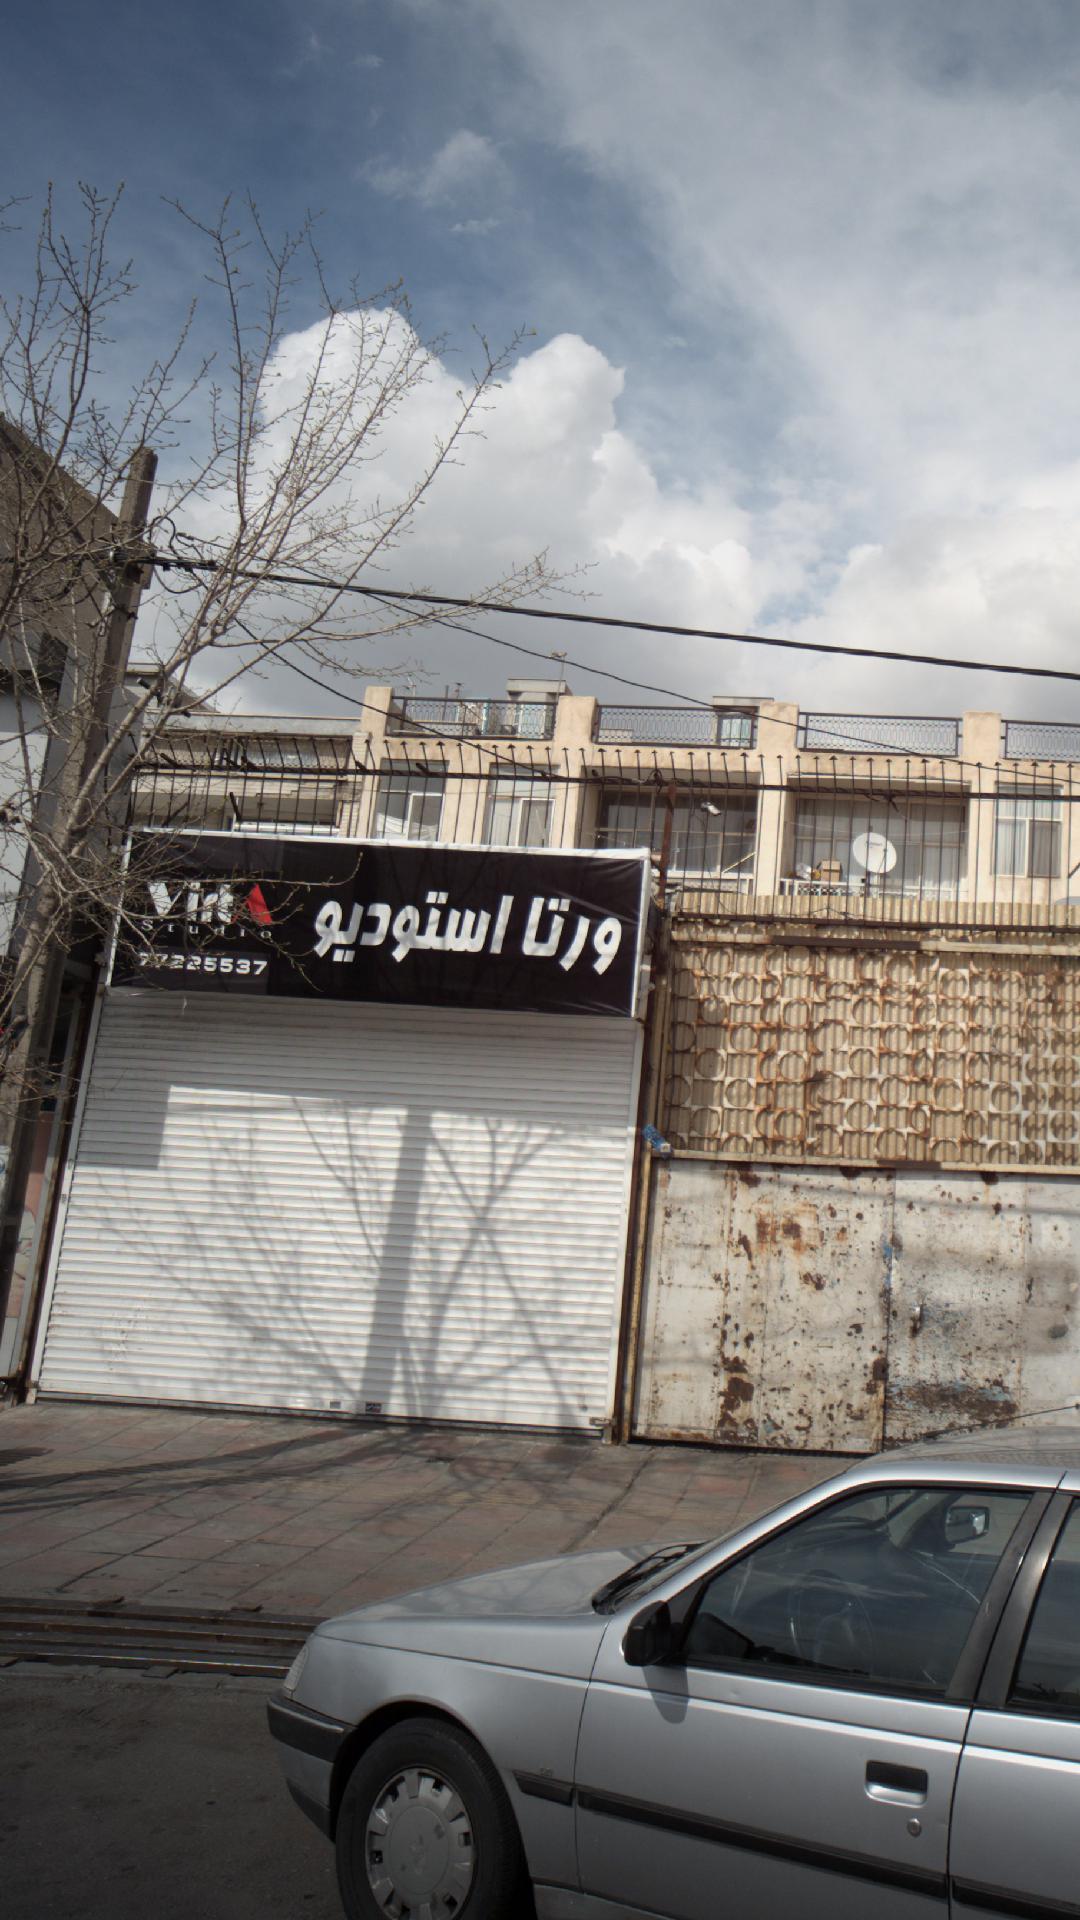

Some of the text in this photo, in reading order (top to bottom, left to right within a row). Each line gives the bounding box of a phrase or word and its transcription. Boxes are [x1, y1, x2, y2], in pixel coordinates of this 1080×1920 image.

[141, 919, 272, 939] Studio
[313, 891, 622, 975] ورتا استودیو
